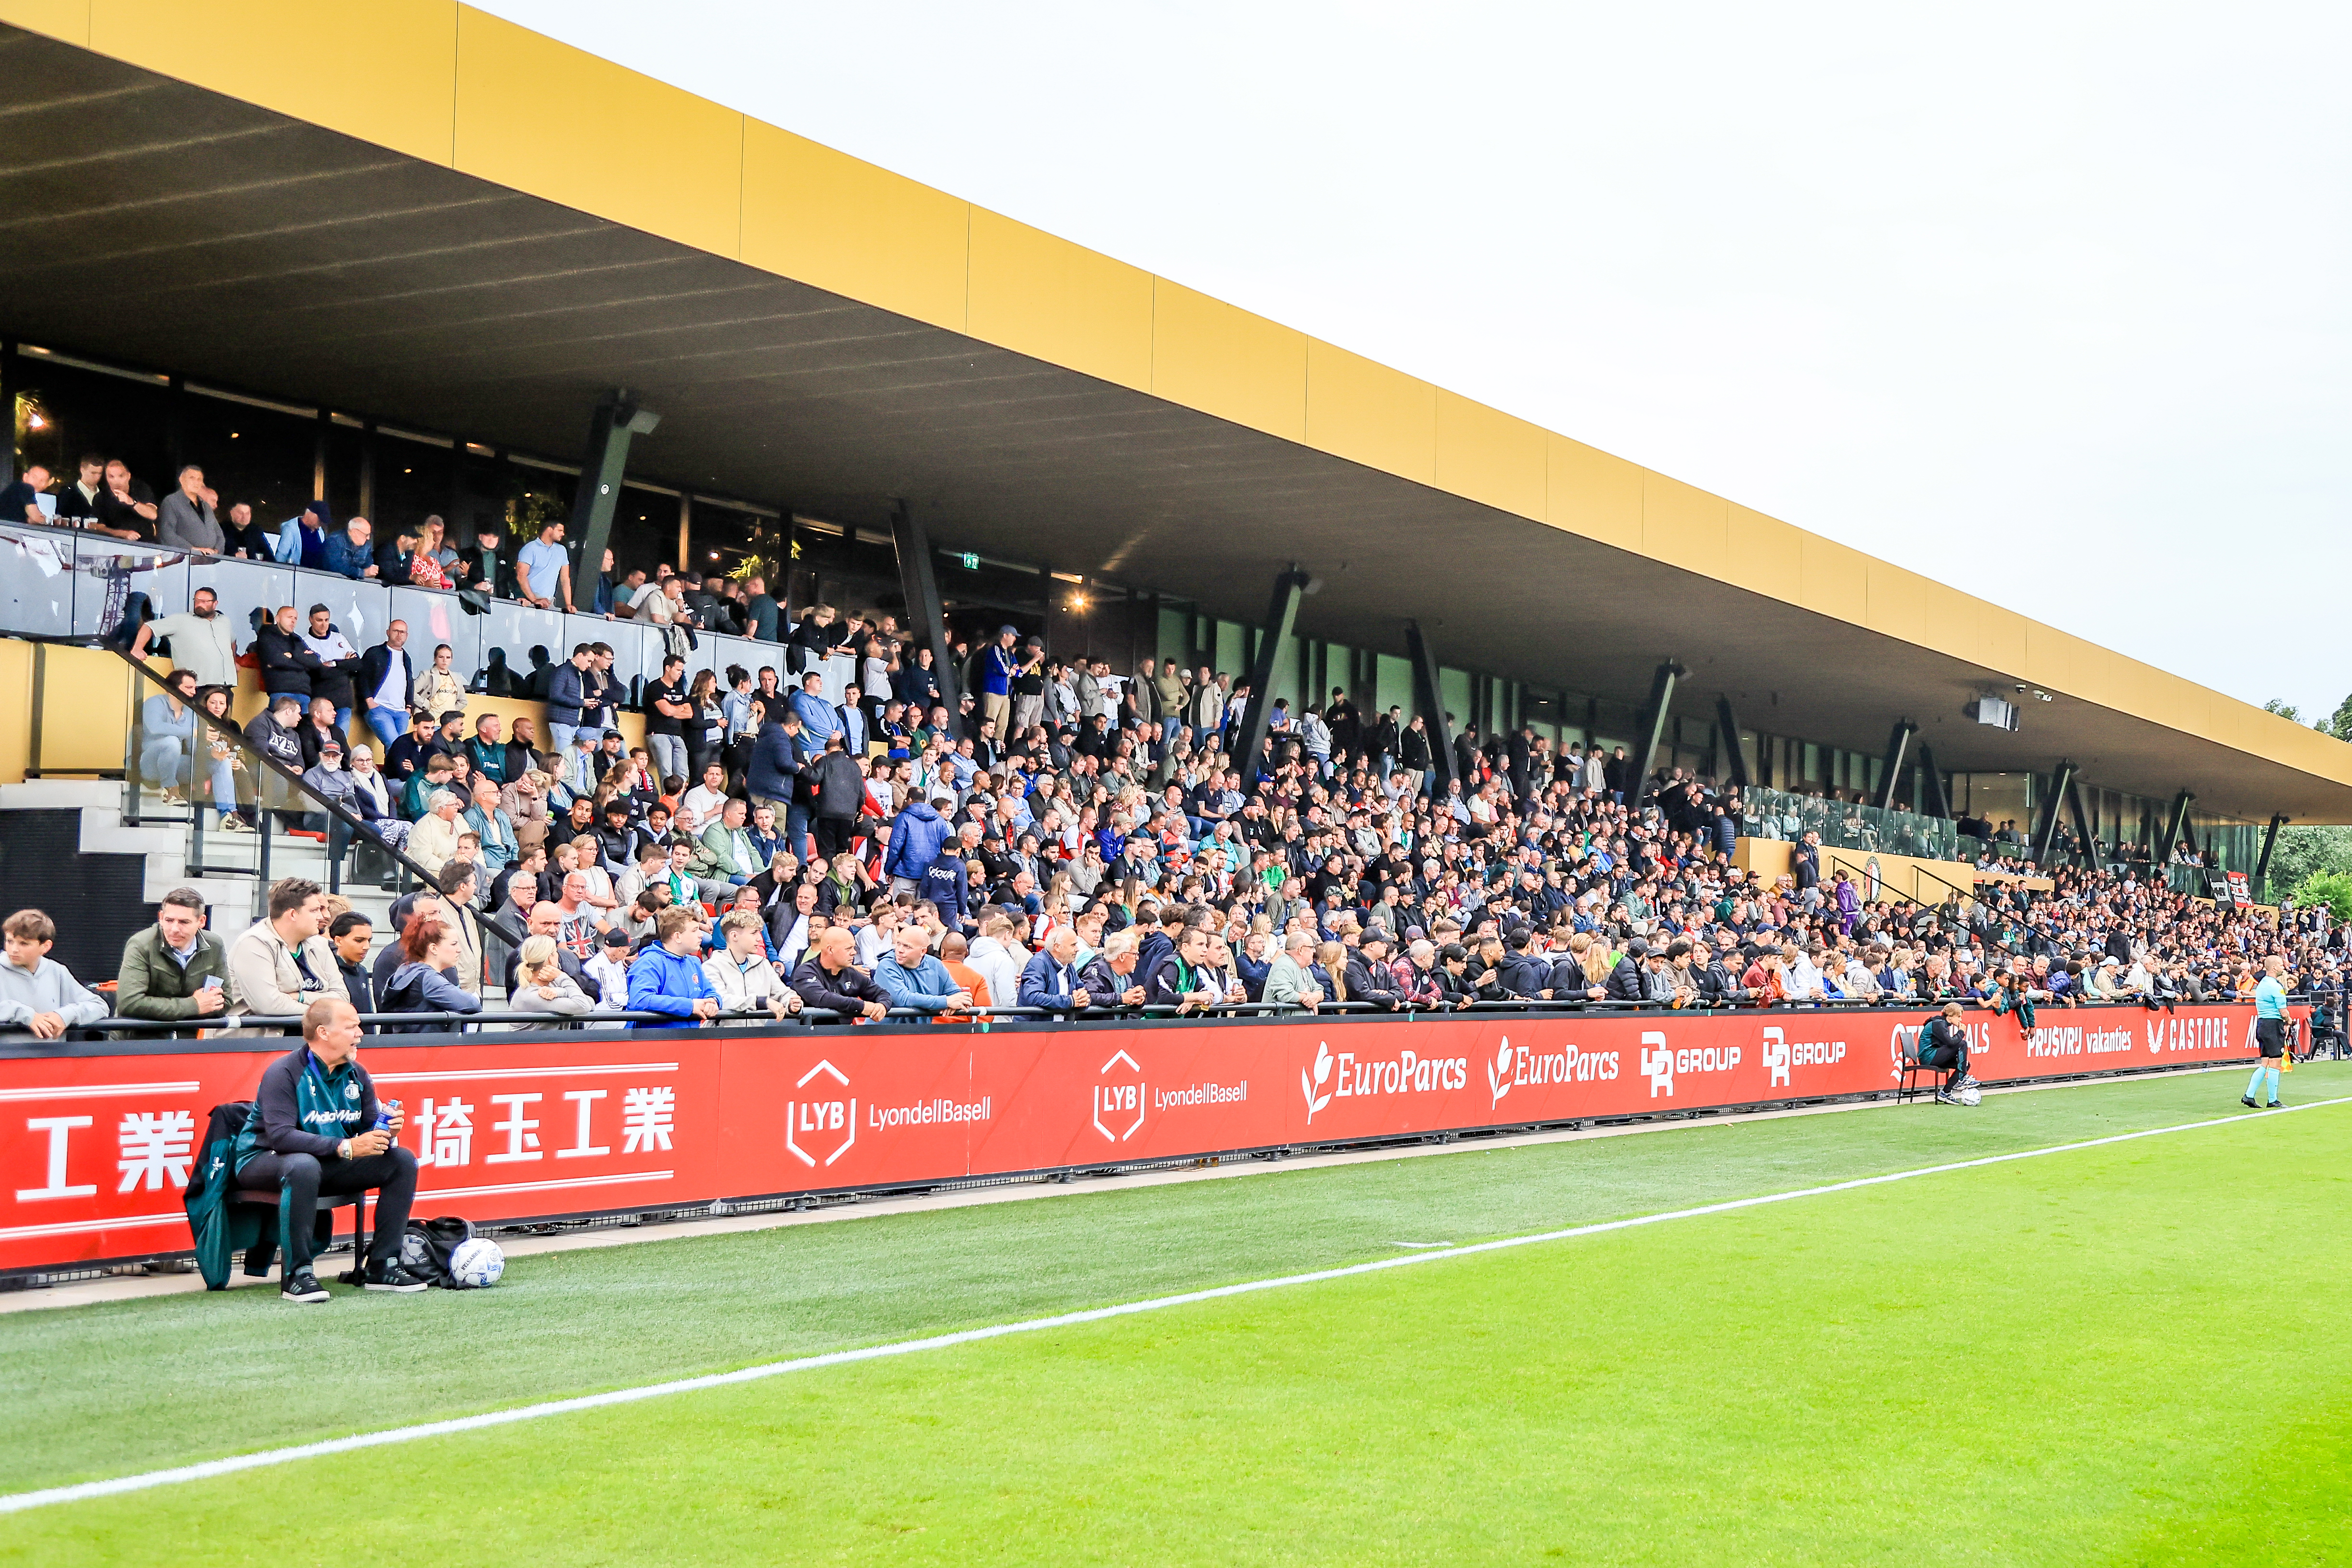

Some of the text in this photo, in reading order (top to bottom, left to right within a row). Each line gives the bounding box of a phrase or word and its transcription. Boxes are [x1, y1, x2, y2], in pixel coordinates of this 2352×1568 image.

[2086, 1025, 2132, 1054] vakanties
[2169, 1017, 2228, 1051] CASTORE
[1514, 1044, 1619, 1086] EuroParcs
[1676, 1046, 1742, 1074] GROUP
[1792, 1041, 1846, 1066] GROUP
[1335, 1050, 1467, 1097] EuroParcs
[1104, 1085, 1137, 1112] LYB
[1155, 1080, 1247, 1112] LyondellBasell
[414, 1086, 676, 1167] 埼玉工業
[800, 1101, 845, 1131] LYB
[869, 1095, 991, 1132] LyondellBasell
[16, 1110, 195, 1202] 工業
